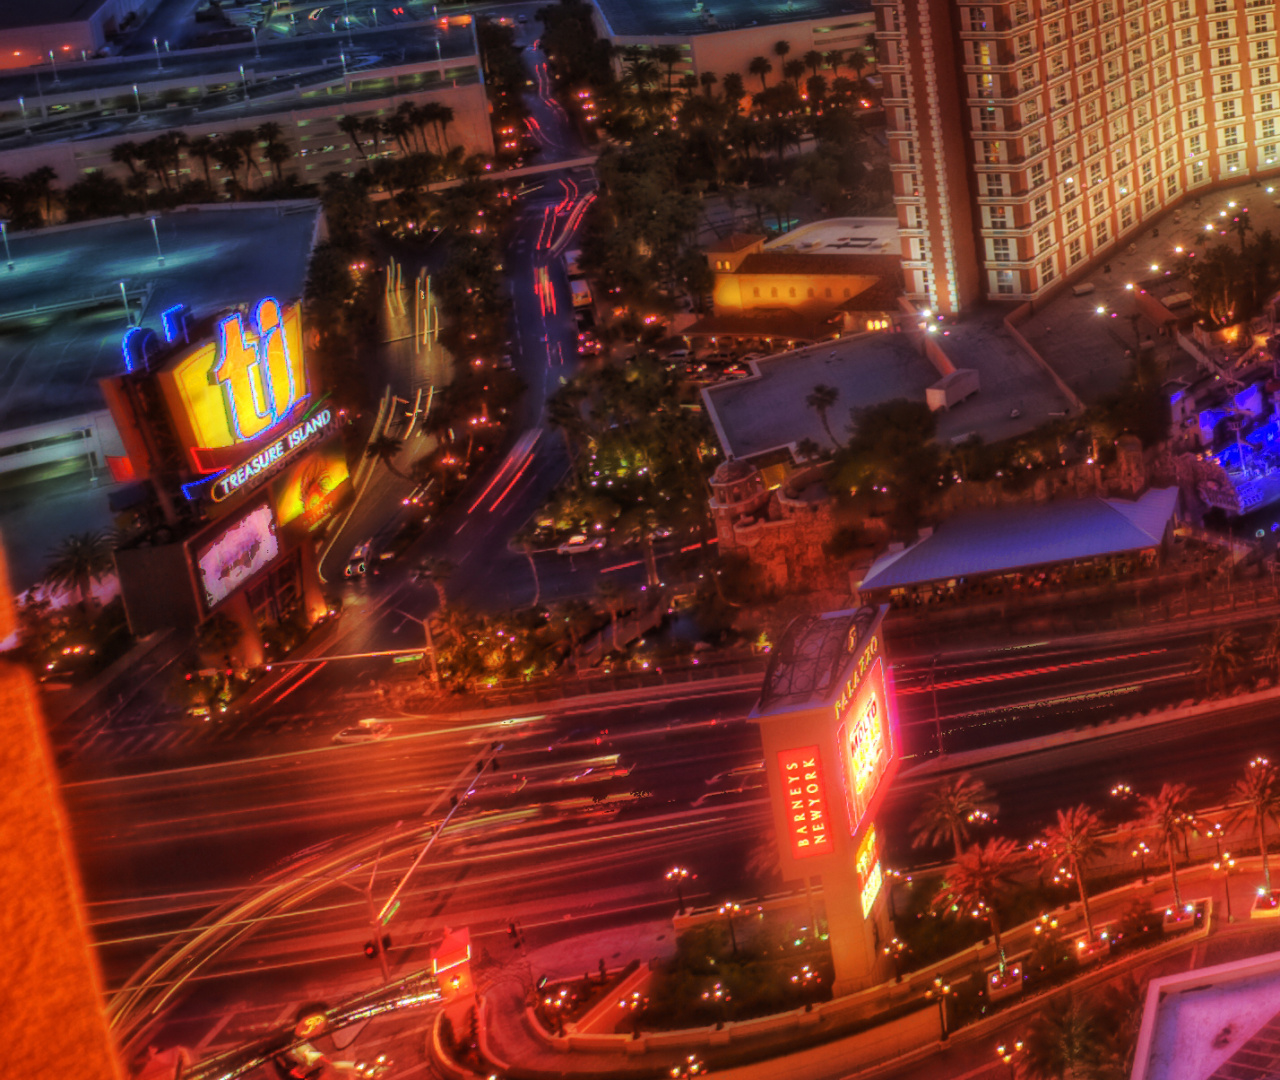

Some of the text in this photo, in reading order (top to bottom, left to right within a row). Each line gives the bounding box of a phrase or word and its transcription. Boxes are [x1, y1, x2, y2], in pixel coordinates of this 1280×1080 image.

[221, 409, 331, 494] TREASURE ISLAND
[834, 635, 878, 720] PALAZZO
[786, 762, 810, 848] BARNEYS
[802, 757, 827, 845] NEW YORK
